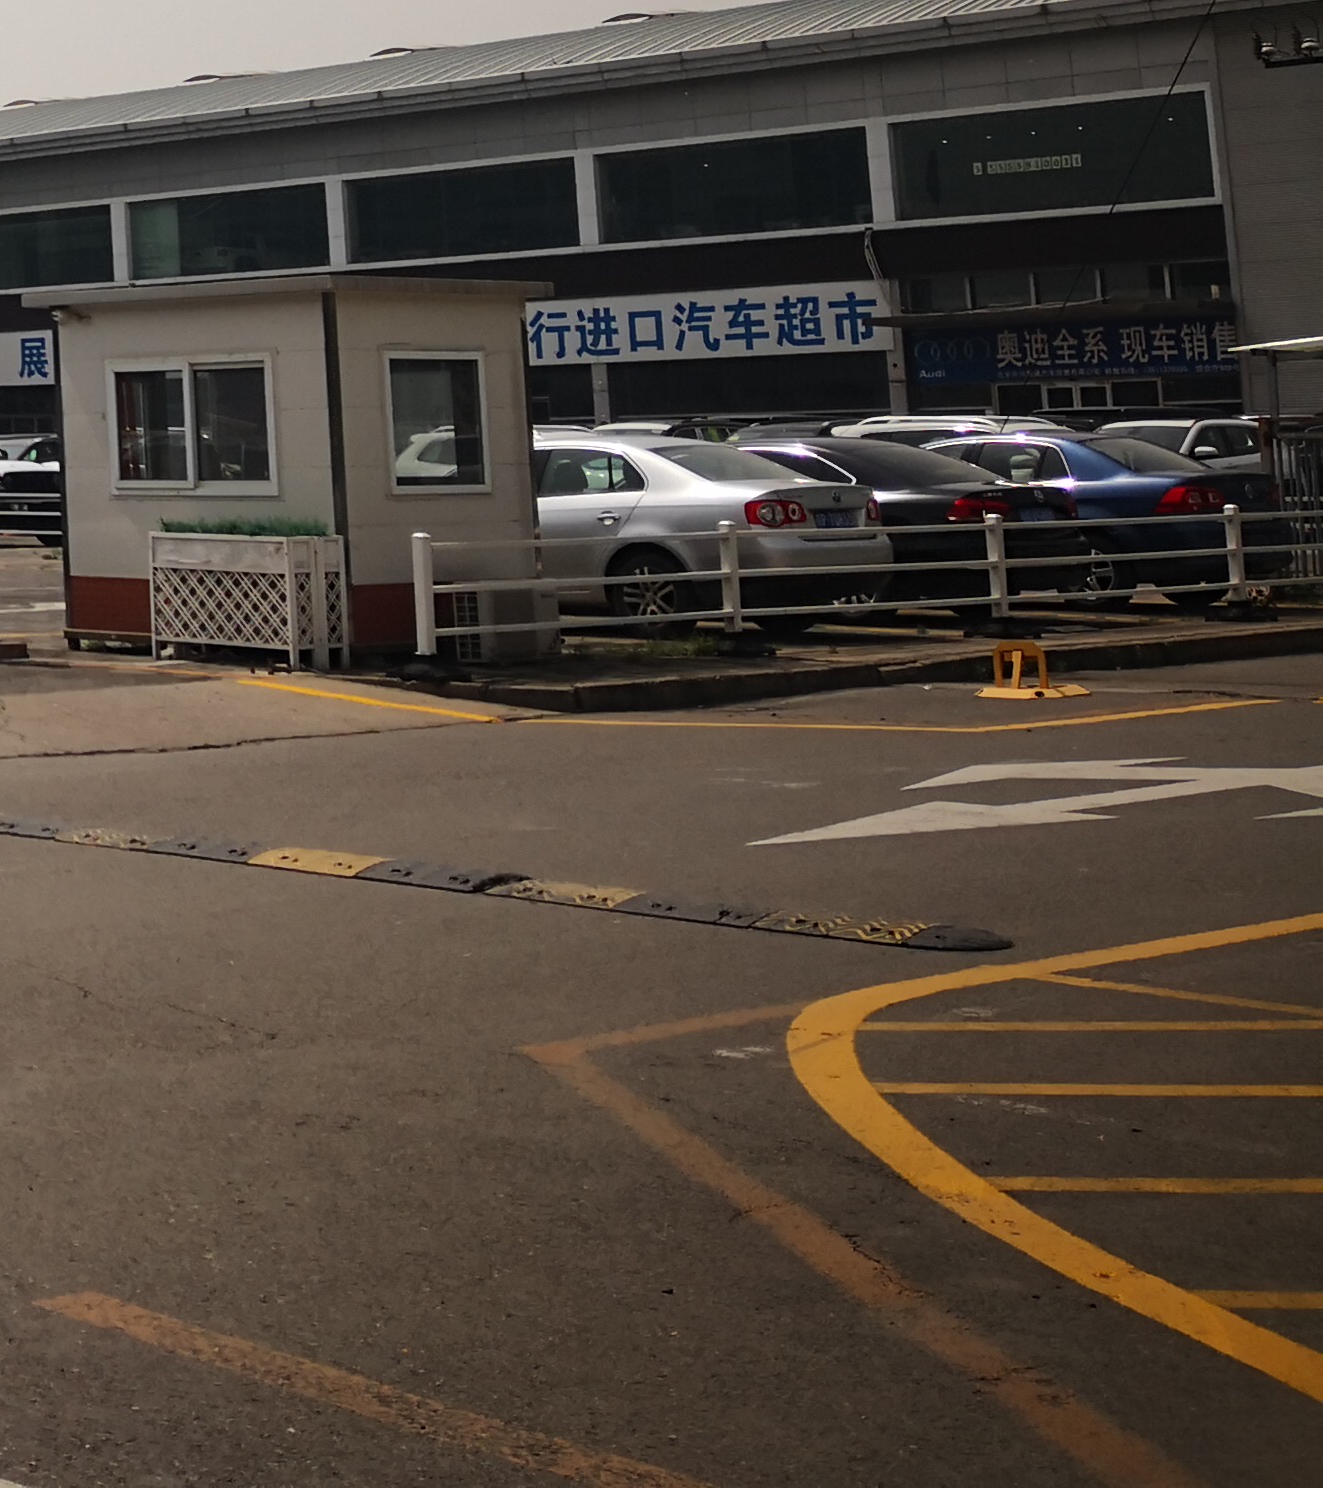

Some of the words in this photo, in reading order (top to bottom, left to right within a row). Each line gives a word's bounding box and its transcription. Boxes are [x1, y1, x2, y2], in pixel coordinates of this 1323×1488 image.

[529, 291, 880, 362] 行进口汽车超市
[996, 324, 1109, 369] 奥迪全系
[1120, 320, 1238, 365] 现车销售
[918, 368, 946, 379] Audi
